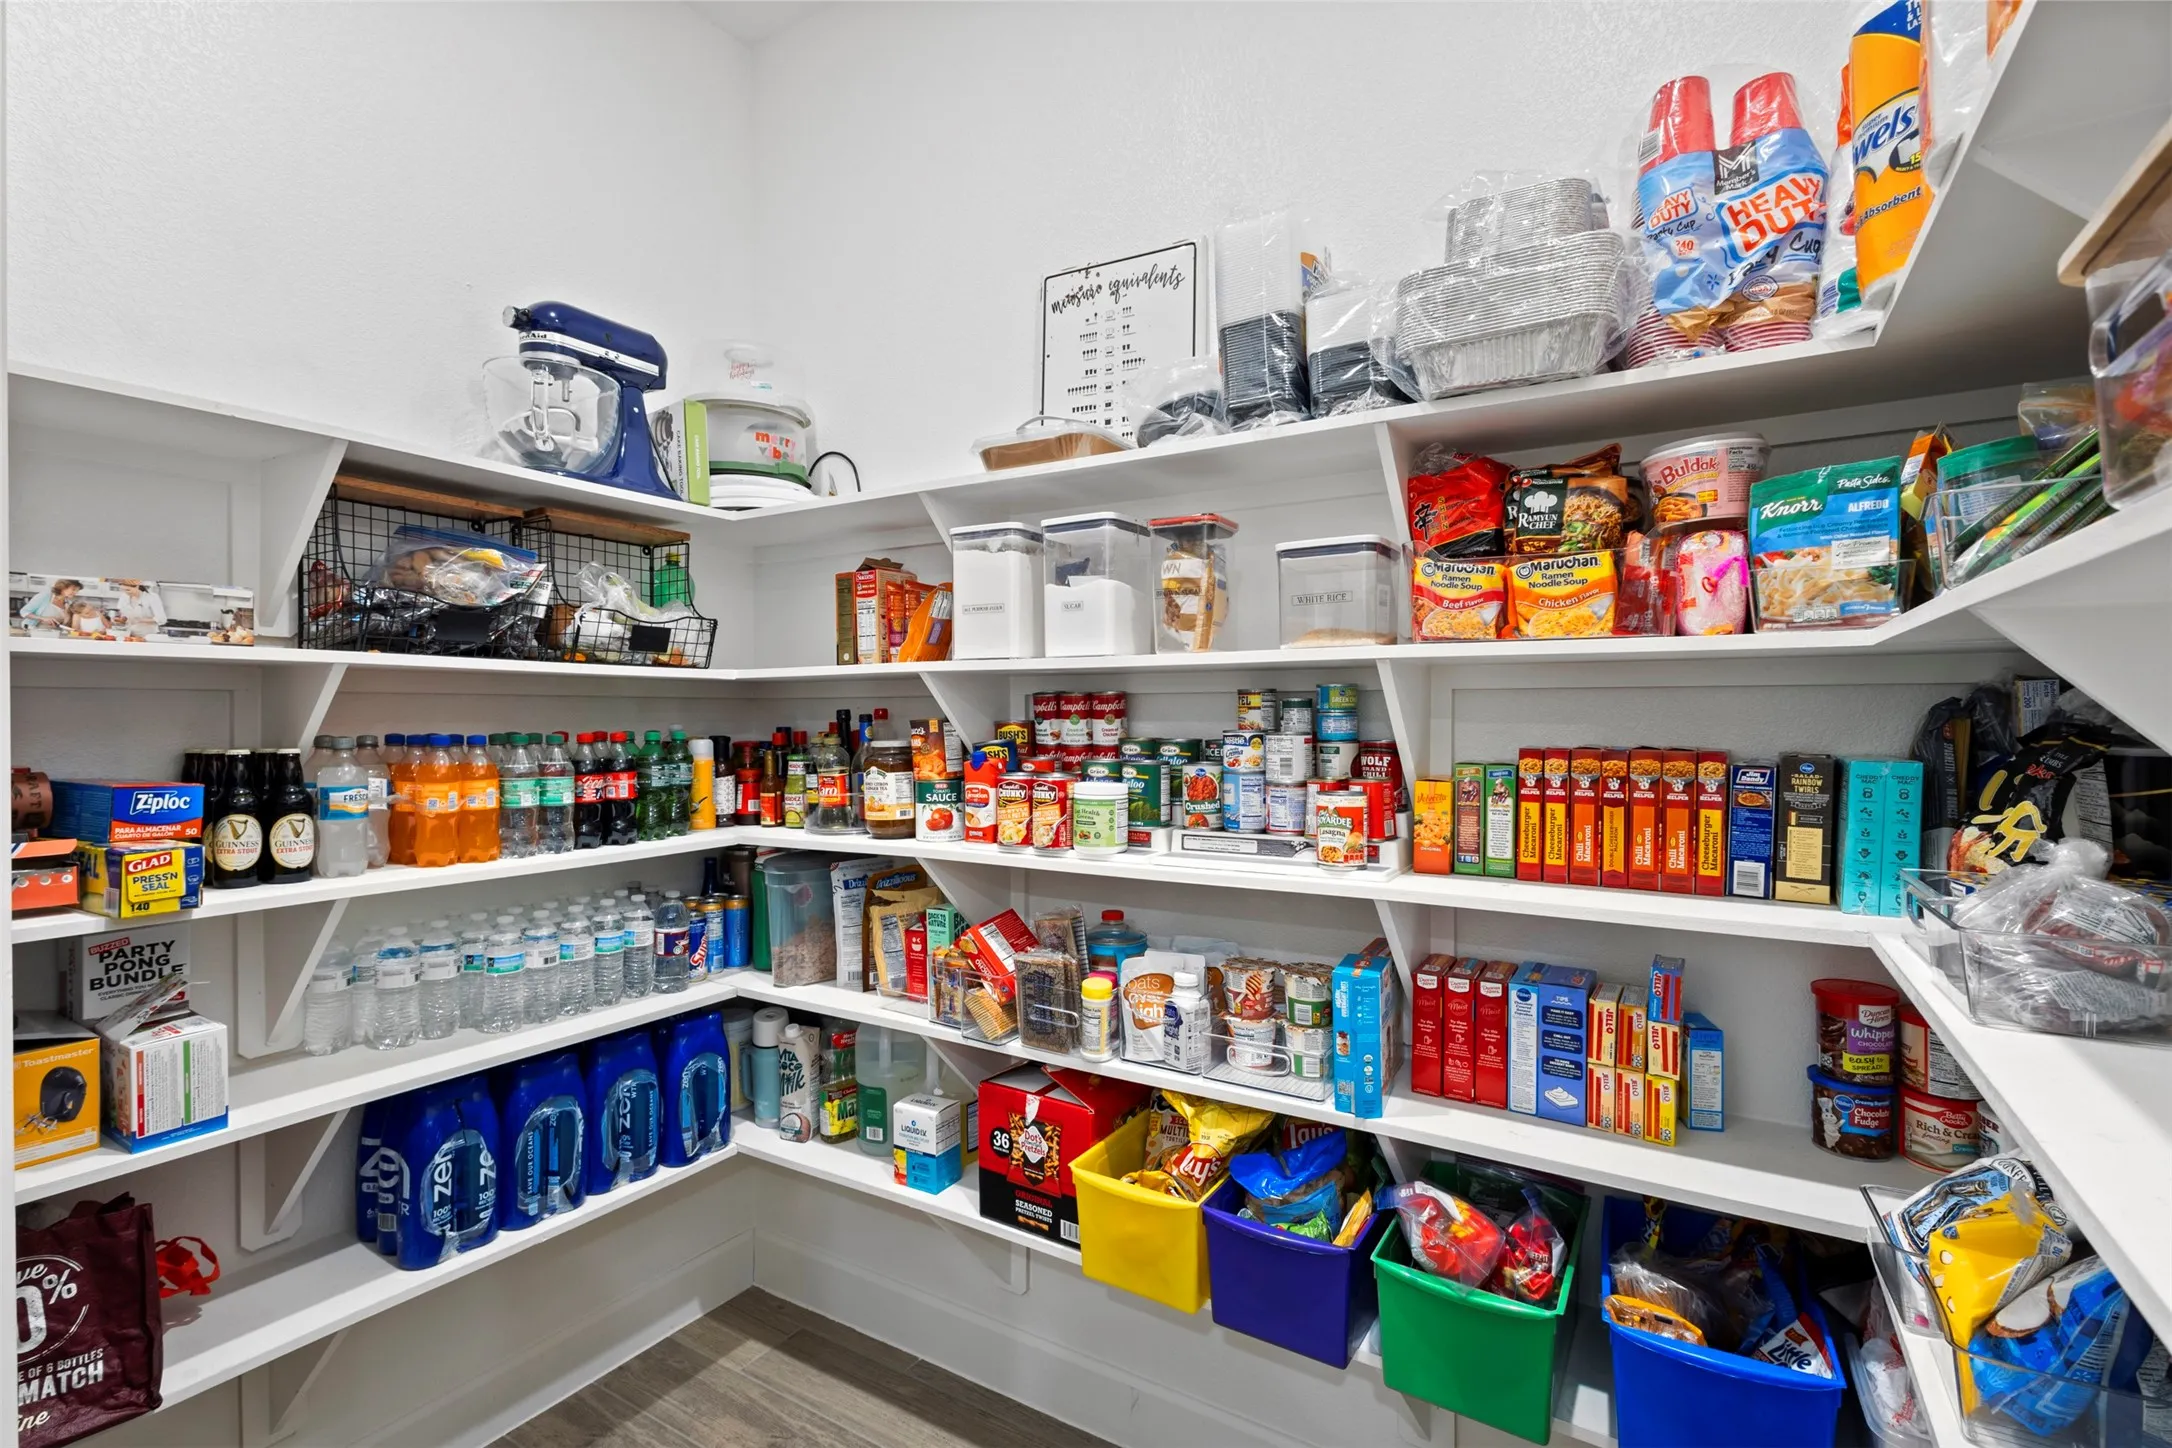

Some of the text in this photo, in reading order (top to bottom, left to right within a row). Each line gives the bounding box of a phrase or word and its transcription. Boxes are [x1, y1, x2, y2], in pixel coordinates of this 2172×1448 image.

[1716, 169, 1756, 186] Member's
[1726, 176, 1821, 226] HEAVY
[1864, 186, 1921, 220] Absorbent
[1651, 200, 1691, 228] DUTY
[1676, 219, 1696, 232] Cup
[1109, 264, 1186, 304] equivalents
[755, 431, 796, 451] merry
[1660, 457, 1719, 485] Buldak
[1837, 474, 1890, 488] Pasta Sides
[1760, 499, 1823, 520] Knorr
[1848, 499, 1889, 513] ALFREDO
[1518, 513, 1558, 528] RAMYUN
[1529, 521, 1557, 530] CHEF
[1434, 560, 1496, 576] Maruchan
[1529, 556, 1599, 573] Maruchan
[1441, 574, 1471, 583] Ramen
[1528, 577, 1588, 589] Noodle Soup
[1541, 571, 1574, 580] Ramen
[1430, 580, 1483, 592] Noodle Soup
[1297, 593, 1347, 604] WHITE RICE
[1442, 598, 1484, 609] Beef Flavor
[1539, 588, 1600, 607] Chicken Flavor
[999, 731, 1027, 740] BUSH'S
[1361, 756, 1391, 767] WOLF
[1791, 778, 1823, 786] RAINBOW
[1794, 785, 1819, 794] TWIRLS
[136, 792, 191, 814] Ziploc
[926, 793, 957, 802] SAUCE
[1081, 809, 1100, 817] Health
[1185, 801, 1220, 811] Crushed
[115, 825, 197, 836] PARA ALMACENAR 50
[115, 832, 139, 840] CUARTO
[1320, 828, 1346, 837] Lasagna
[1523, 807, 1532, 858] Cheeseburger
[1548, 808, 1557, 860] Cheeseburger
[216, 840, 259, 849] GUINNESS
[1584, 824, 1592, 862] Macaroni
[1643, 827, 1652, 866] Macaroni
[1677, 830, 1686, 869] Macaroni
[1701, 814, 1712, 871] Cheeseburger
[1576, 842, 1584, 861] Chili
[1635, 846, 1643, 865] Chili
[1668, 848, 1677, 869] Chili
[1710, 832, 1719, 871] Macaroni
[128, 856, 171, 872] GLAD
[132, 872, 178, 884] PRESS'N
[142, 881, 170, 892] SEAL
[130, 903, 150, 912] 140
[928, 920, 947, 929] NATURE
[89, 938, 129, 955] BUZZED
[99, 940, 176, 963] PARTY
[104, 954, 170, 975] PONG
[89, 963, 187, 992] BUNDLE
[1128, 977, 1160, 990] oats
[1861, 1009, 1890, 1019] Duncan
[1851, 1027, 1894, 1041] Whipped
[22, 1048, 95, 1069] Toastmaster
[779, 1049, 798, 1062] VITA
[1849, 1056, 1875, 1065] easy
[779, 1060, 803, 1072] COCO
[779, 1069, 806, 1097] Milk
[1854, 1108, 1890, 1118] Chocolate
[1940, 1116, 1968, 1126] Crocker
[1944, 1111, 1966, 1120] Betty
[901, 1125, 920, 1135] LIQUID
[1854, 1118, 1880, 1127] Fudge
[1916, 1119, 1980, 1139] Rich & Crea
[993, 1130, 1010, 1150] 36
[1024, 1129, 1043, 1144] Dot's
[1921, 1132, 1951, 1145] frosting
[1020, 1140, 1047, 1157] Pretzels
[1179, 1150, 1222, 1186] Lay's
[434, 1153, 452, 1202] zen
[1015, 1189, 1053, 1208] ORIGINAL
[1015, 1199, 1053, 1218] SEASONED
[1015, 1207, 1053, 1225] PRETZEL TWISTS
[28, 1365, 42, 1379] OF
[46, 1362, 53, 1374] 6
[57, 1347, 104, 1371] BOTTLES
[1770, 1340, 1813, 1371] Little
[18, 1360, 104, 1406] MATCH
[17, 1410, 51, 1433] ine
